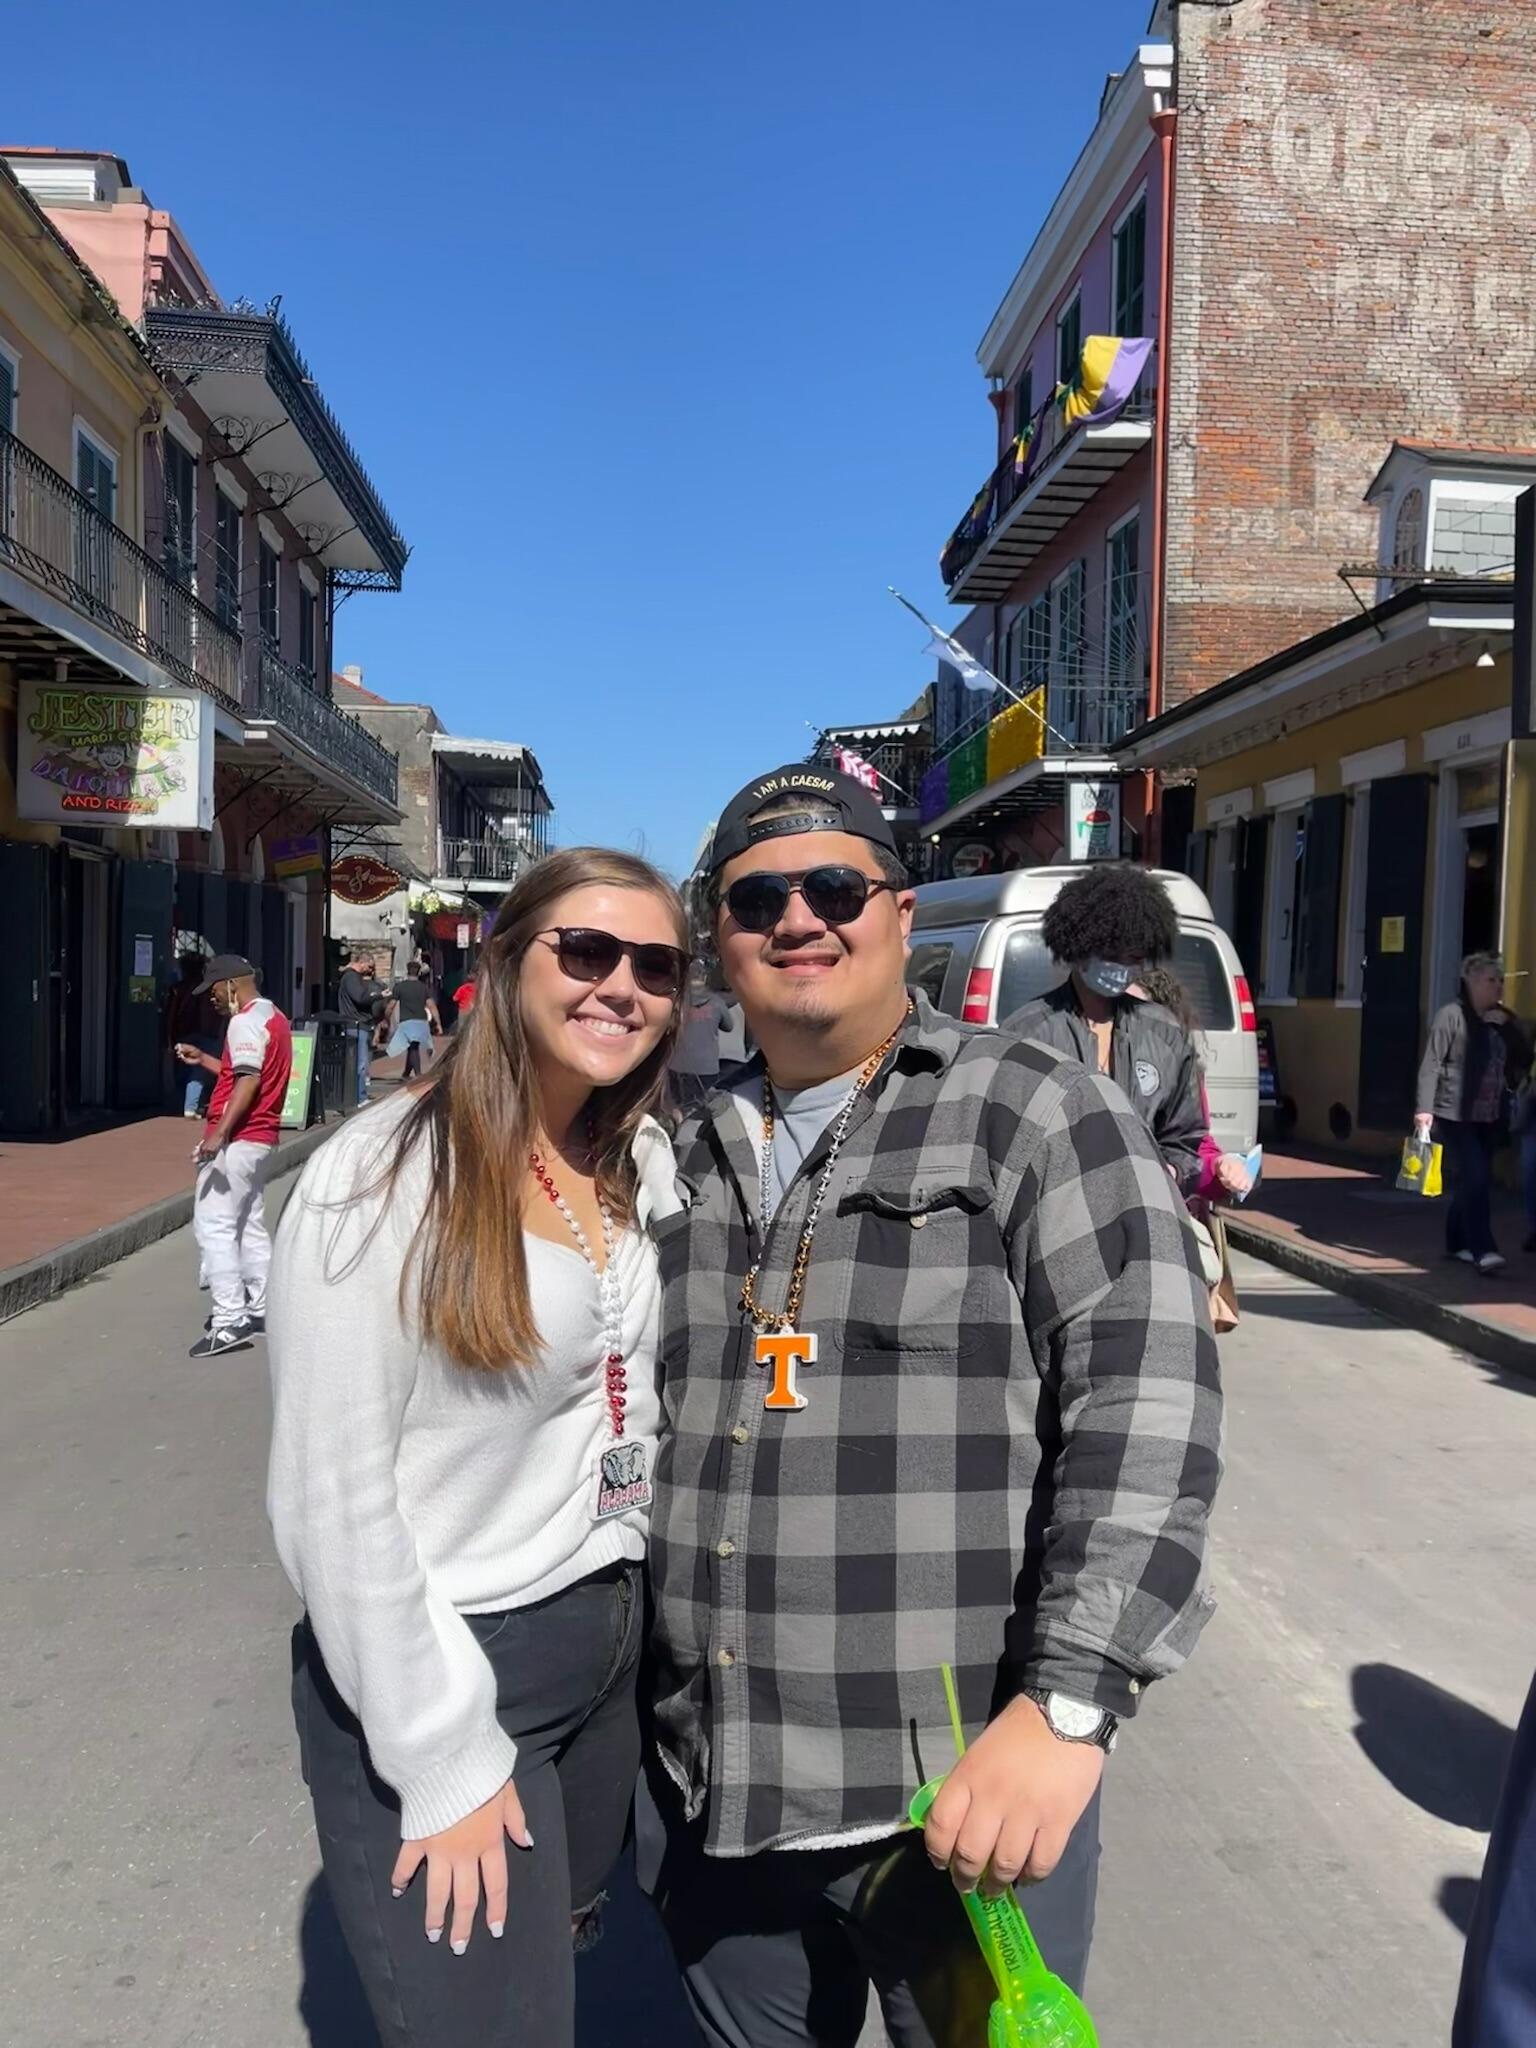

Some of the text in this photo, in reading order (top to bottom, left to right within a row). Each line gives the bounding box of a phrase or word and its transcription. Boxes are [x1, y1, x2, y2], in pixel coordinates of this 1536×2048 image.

[27, 689, 199, 740] JESTER
[63, 796, 101, 809] AND
[753, 774, 835, 799] I AM A CAESAR
[755, 1333, 818, 1409] T
[986, 1914, 1022, 1973] TROPICAL
